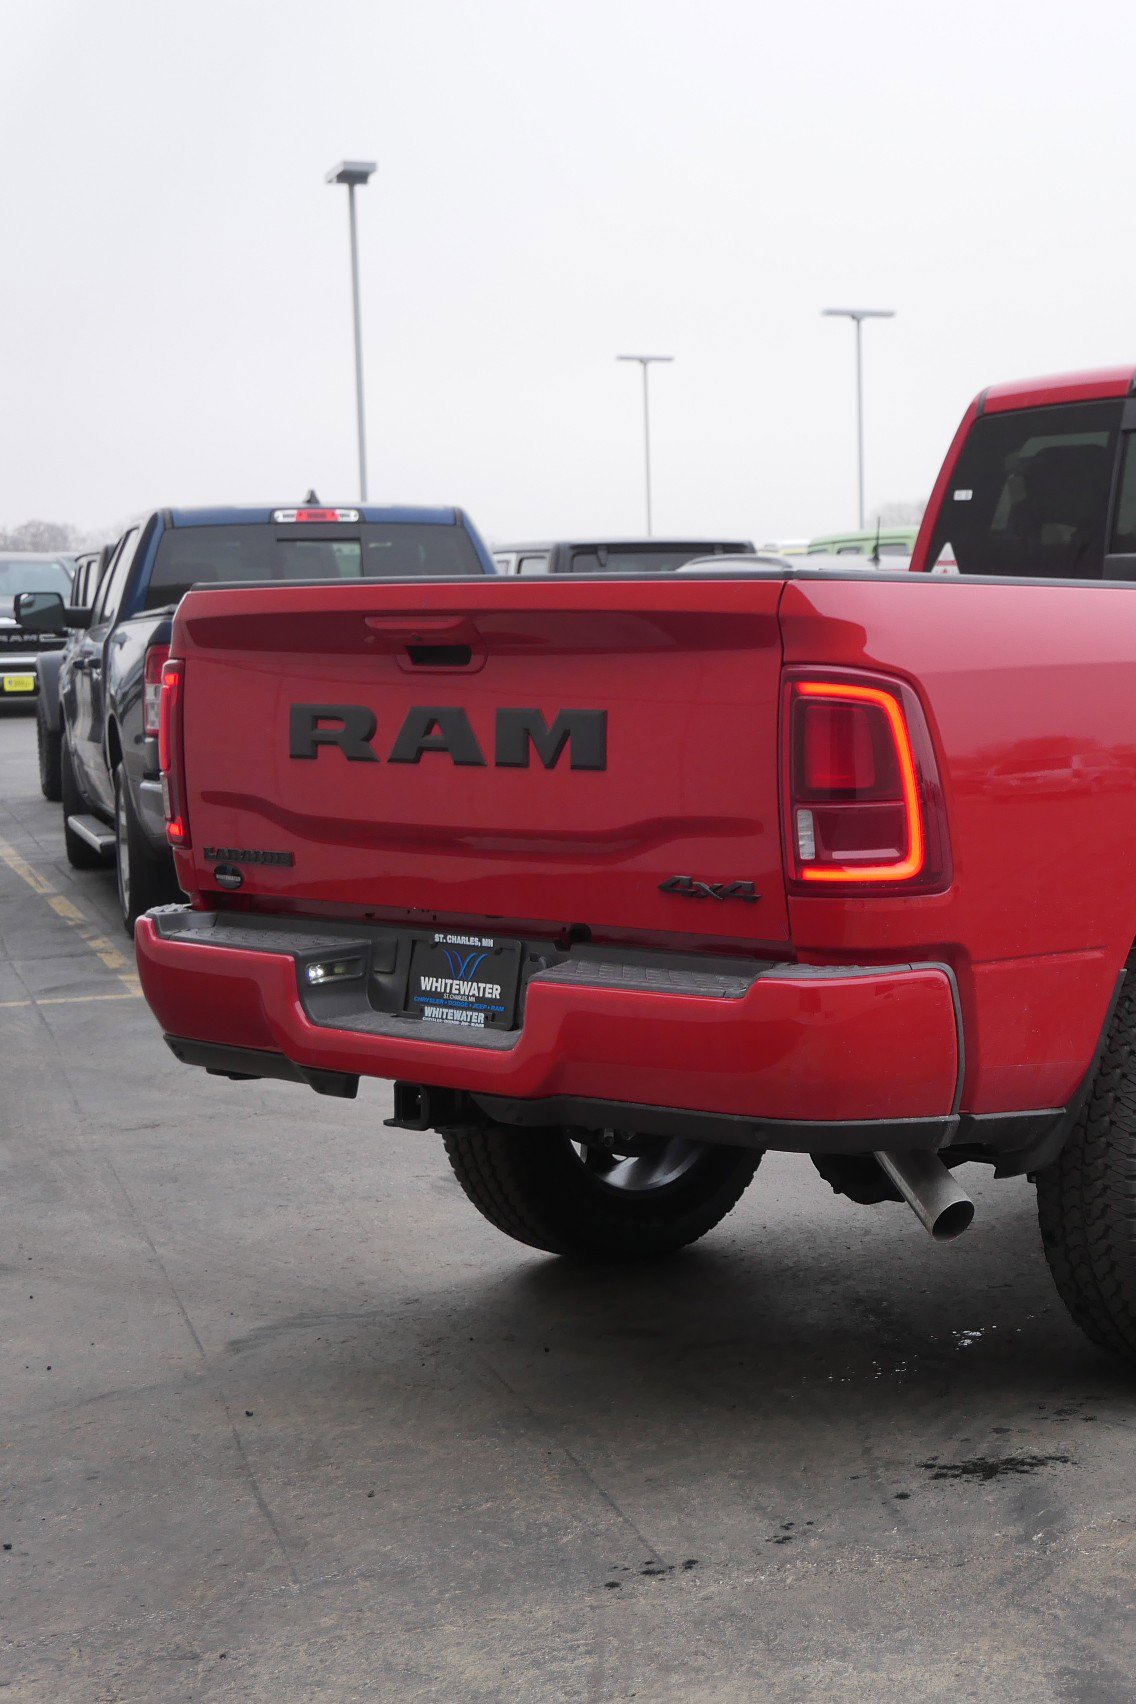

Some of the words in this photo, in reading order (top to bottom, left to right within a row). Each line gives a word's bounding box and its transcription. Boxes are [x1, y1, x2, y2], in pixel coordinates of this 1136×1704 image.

[289, 703, 608, 771] RAM
[658, 875, 762, 903] 4x4
[434, 934, 446, 943] ST.
[447, 935, 481, 947] CHARLES,
[482, 938, 494, 947] MN
[420, 976, 501, 999] WHITEWATER
[424, 1006, 485, 1023] WHITEWATER
